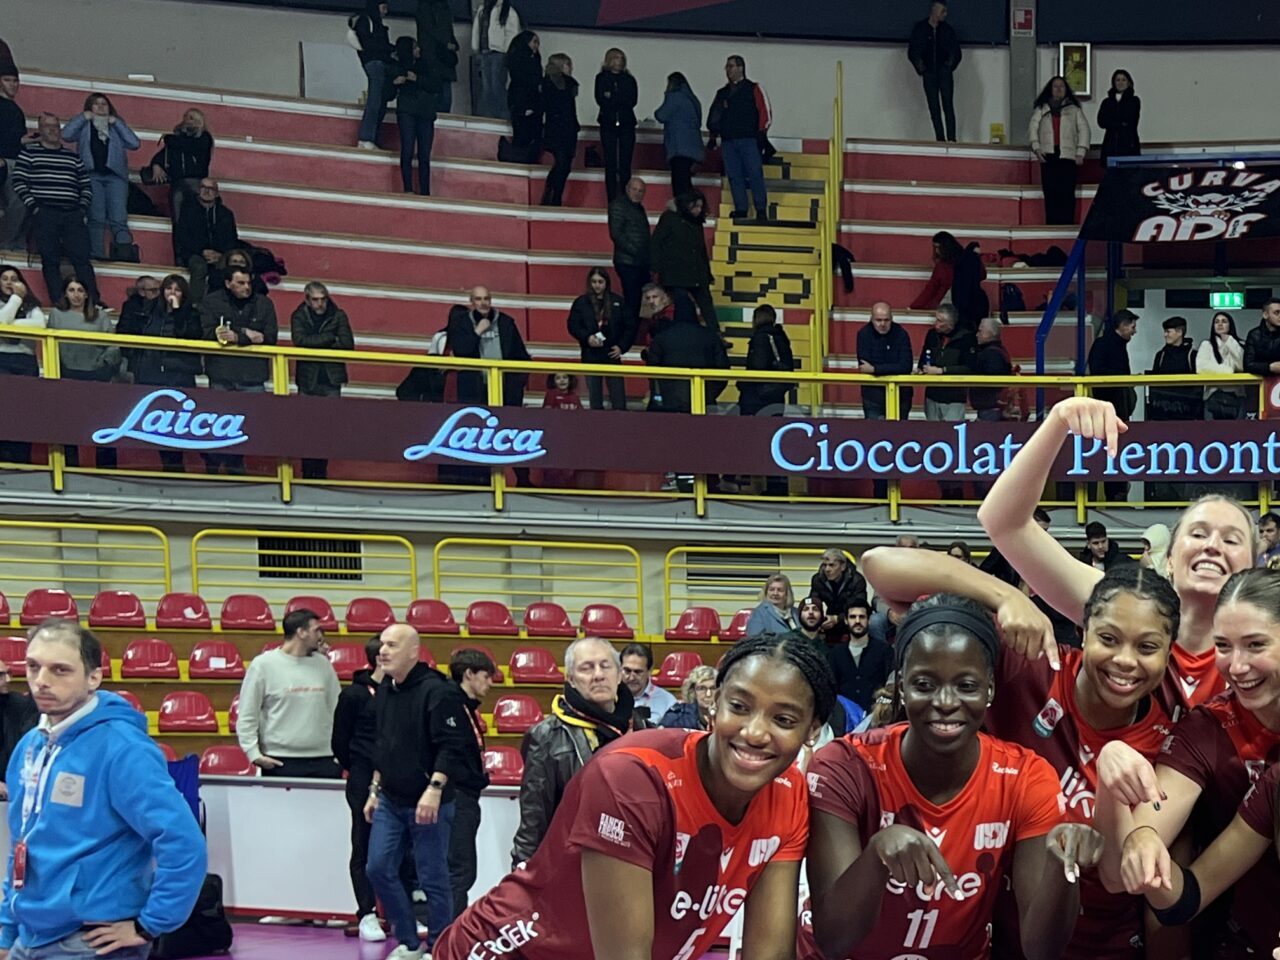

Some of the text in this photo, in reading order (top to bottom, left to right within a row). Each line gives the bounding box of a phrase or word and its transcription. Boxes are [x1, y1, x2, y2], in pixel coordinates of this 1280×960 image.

[1132, 212, 1268, 242] ADF
[92, 389, 249, 449] Laica
[403, 406, 547, 465] Laica
[770, 422, 1023, 474] Cioccolat
[902, 908, 940, 949] 11
